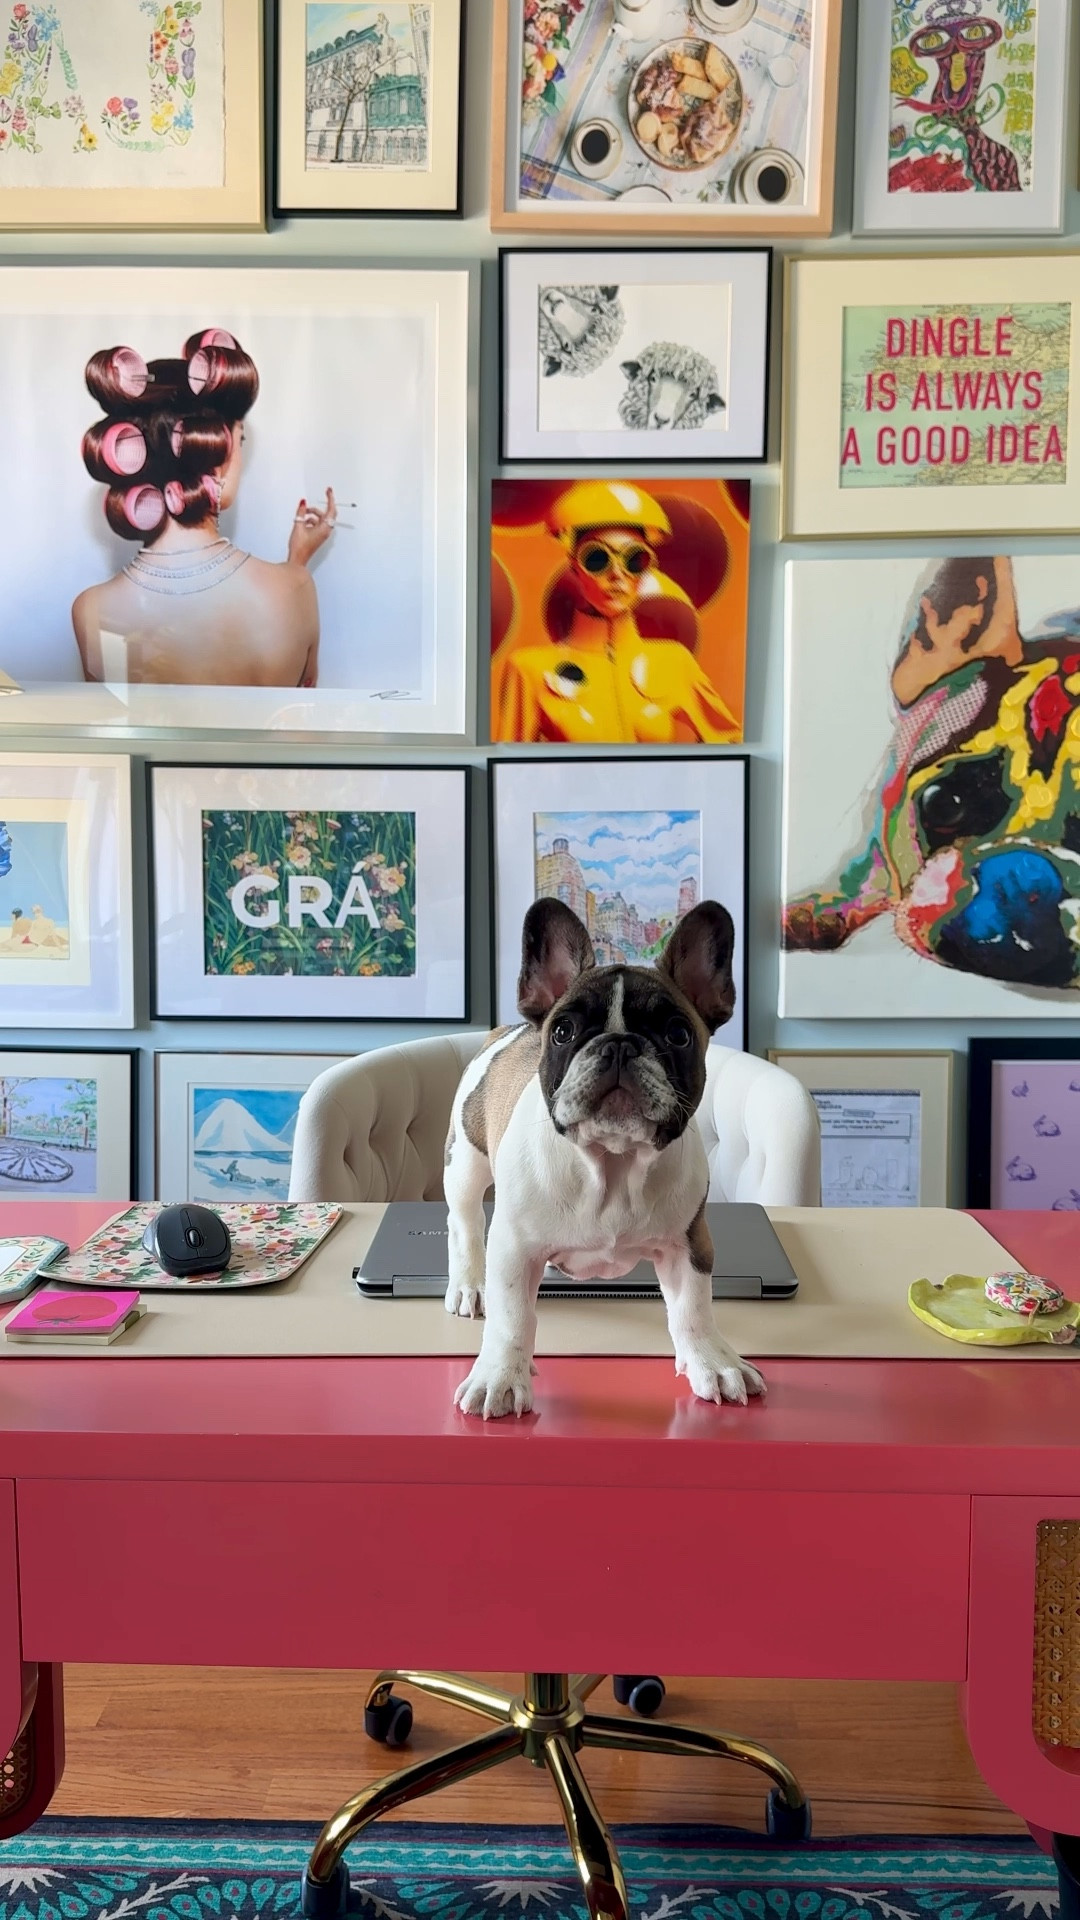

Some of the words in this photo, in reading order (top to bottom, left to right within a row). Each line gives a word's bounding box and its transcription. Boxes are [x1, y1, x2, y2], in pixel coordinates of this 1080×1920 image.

[886, 316, 1014, 358] DINGLE
[864, 371, 899, 412] IS
[911, 370, 1043, 412] ALWAYS
[840, 426, 862, 466] A
[876, 424, 971, 466] GOOD
[986, 423, 1064, 465] IDEA
[231, 860, 381, 929] GRÁ
